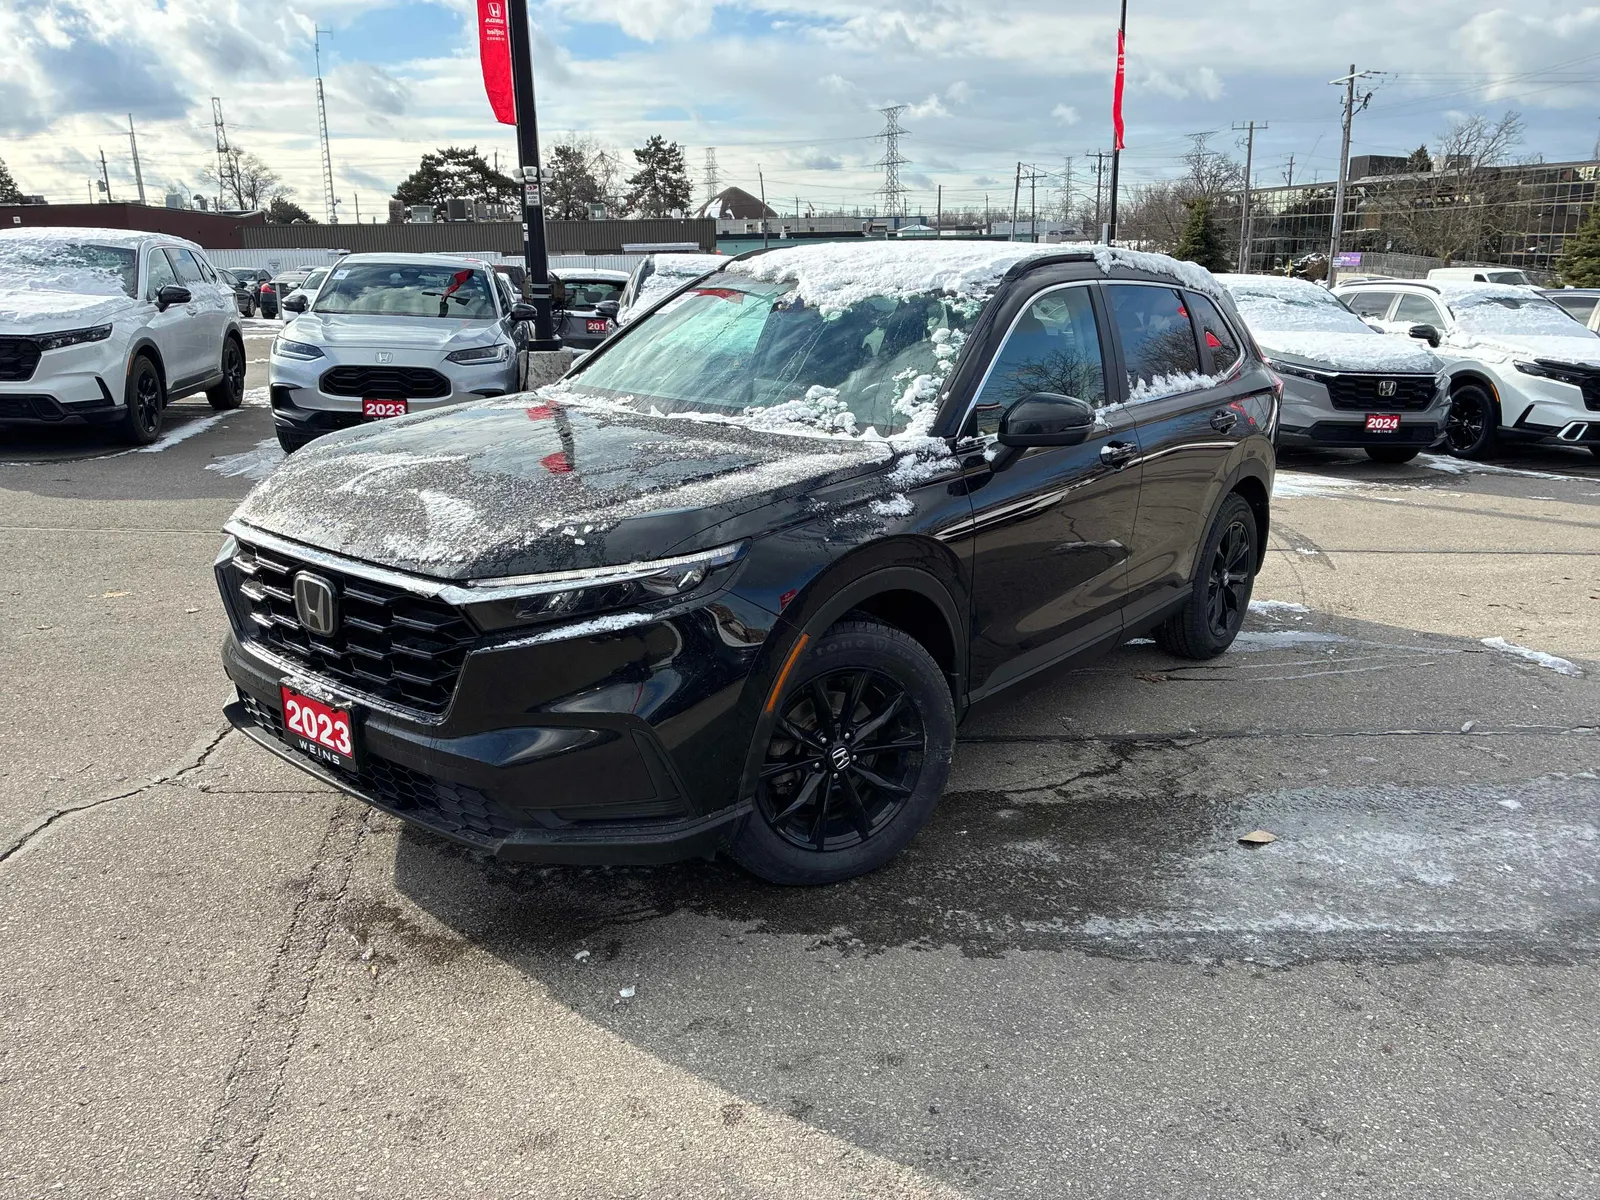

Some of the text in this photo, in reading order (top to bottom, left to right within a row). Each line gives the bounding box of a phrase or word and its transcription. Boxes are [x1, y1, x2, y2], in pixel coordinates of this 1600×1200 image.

[588, 322, 605, 331] 201
[366, 403, 406, 416] 2023
[1367, 418, 1398, 429] 2024
[286, 700, 352, 754] 2023
[299, 739, 341, 765] WEINS
